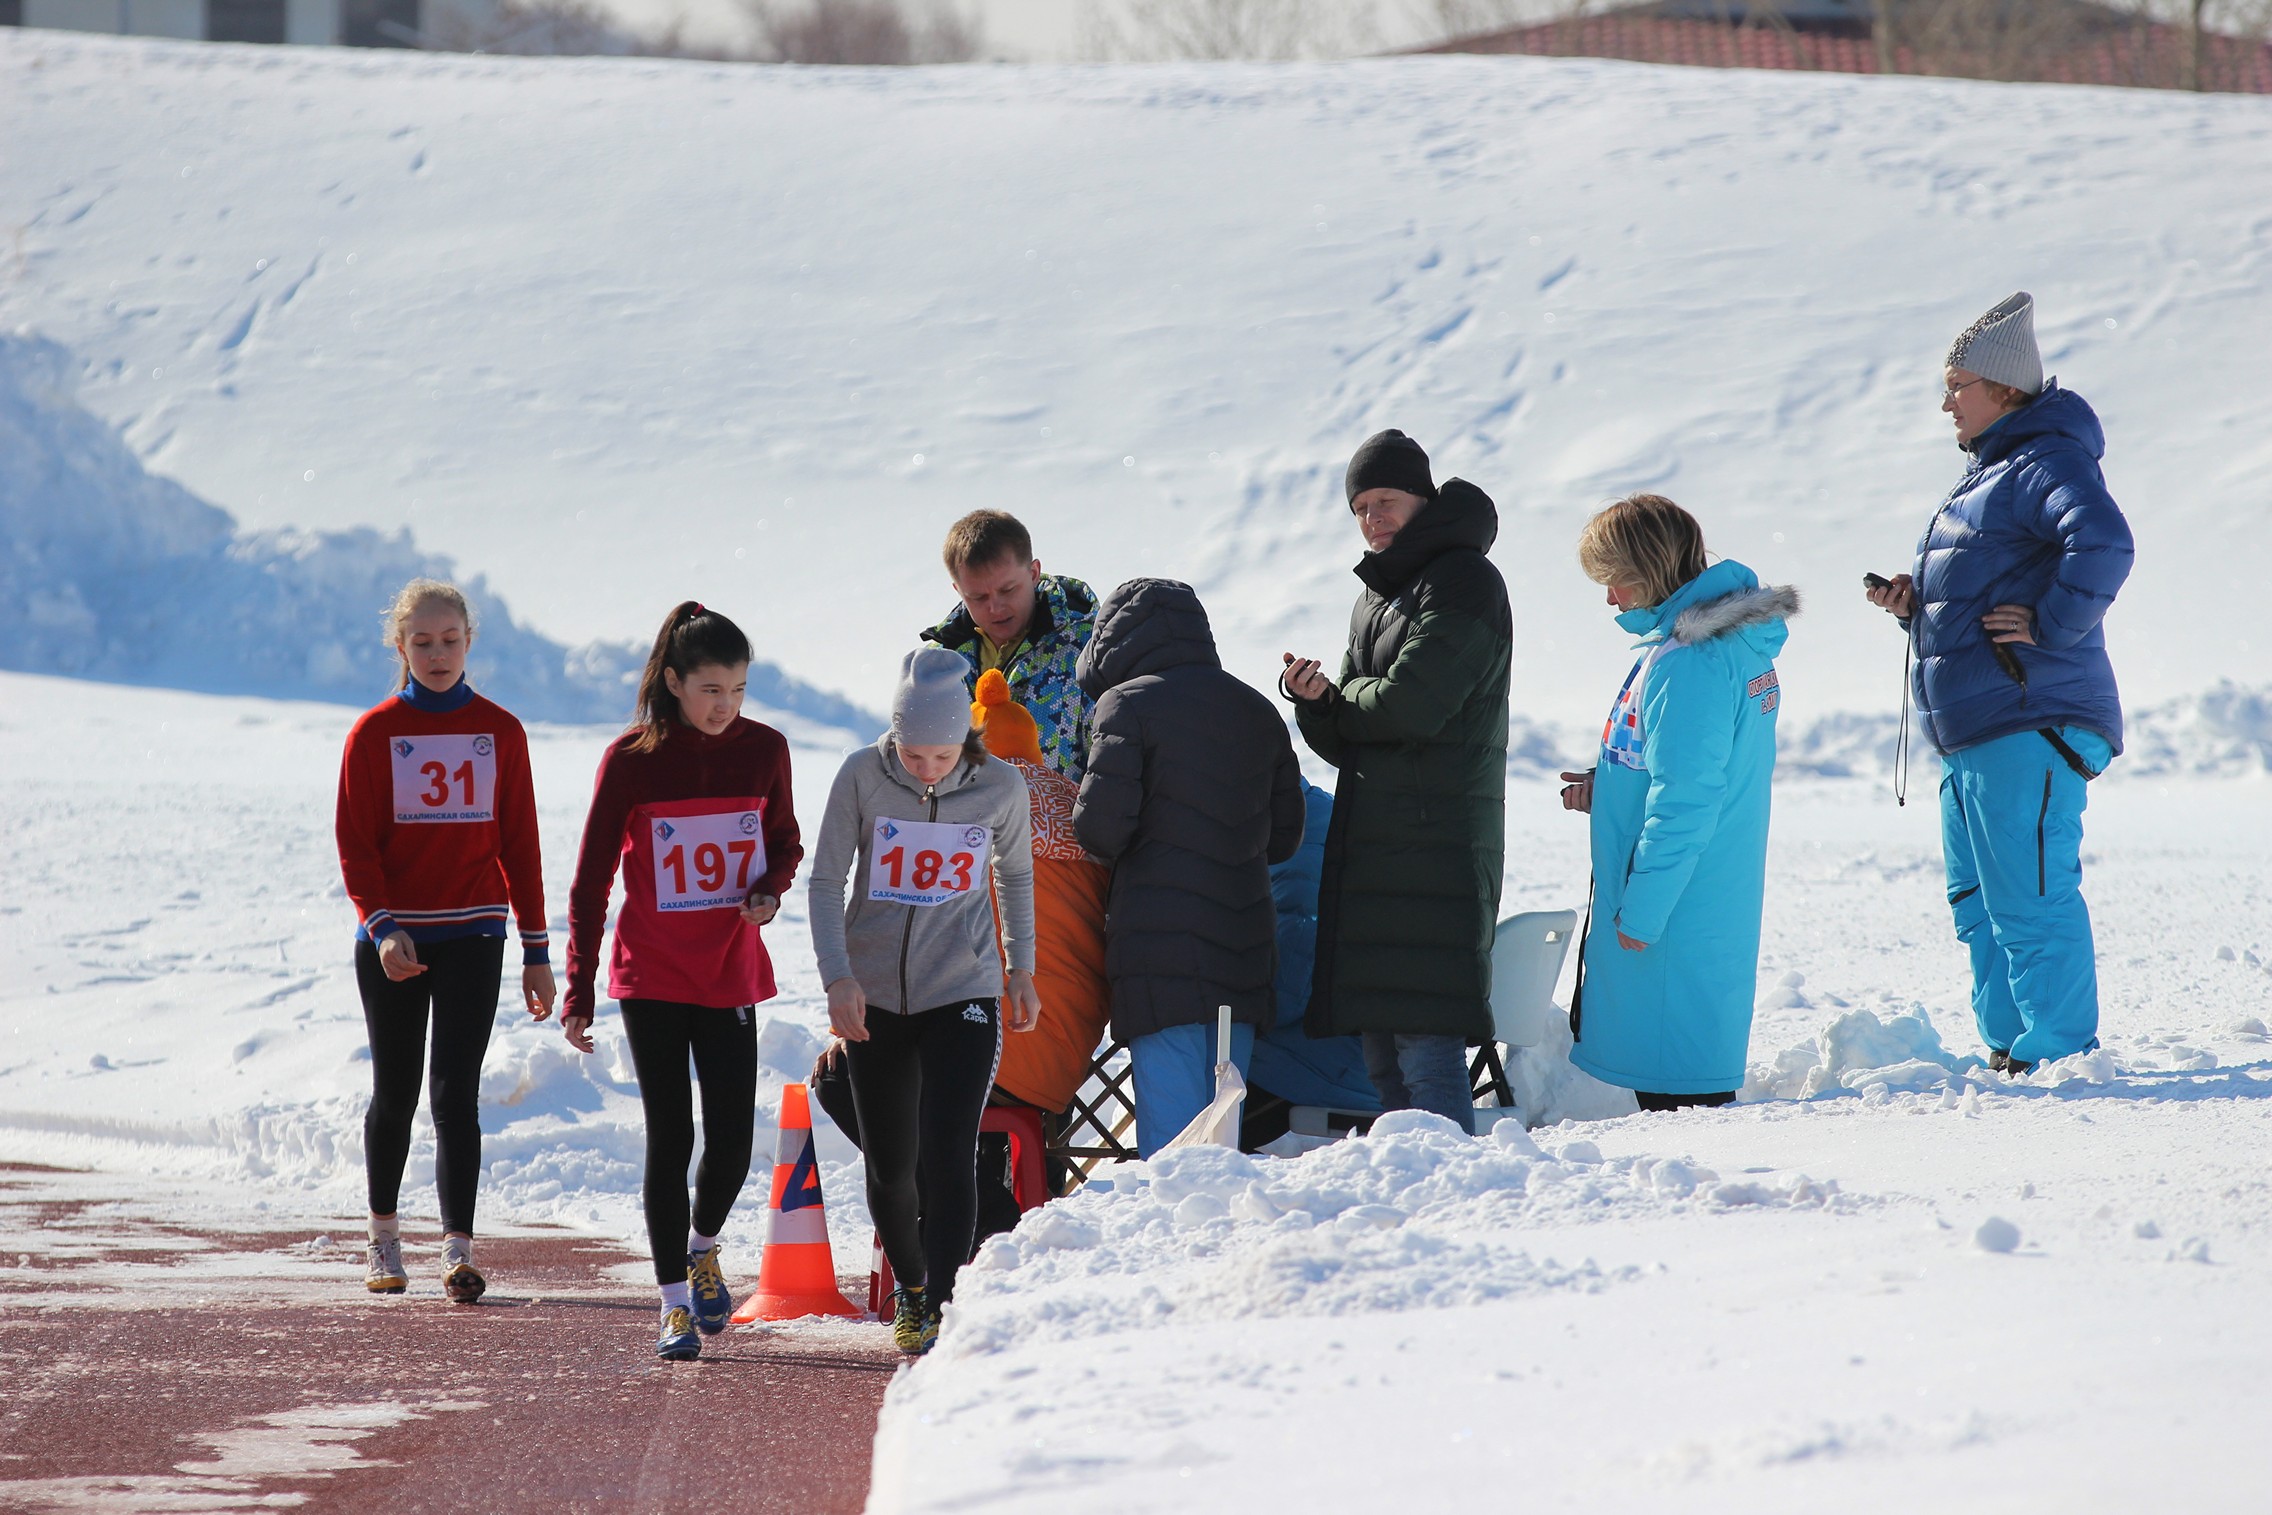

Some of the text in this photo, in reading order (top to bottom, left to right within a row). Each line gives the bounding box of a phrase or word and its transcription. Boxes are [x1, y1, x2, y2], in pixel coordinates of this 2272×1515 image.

[420, 760, 474, 807] 31
[397, 812, 457, 821] САХАЛИНСКАЯ
[662, 839, 756, 894] 197
[880, 845, 974, 891] 183
[660, 897, 723, 910] САХАЛИНСКАЯ
[963, 1013, 988, 1024] Kappa
